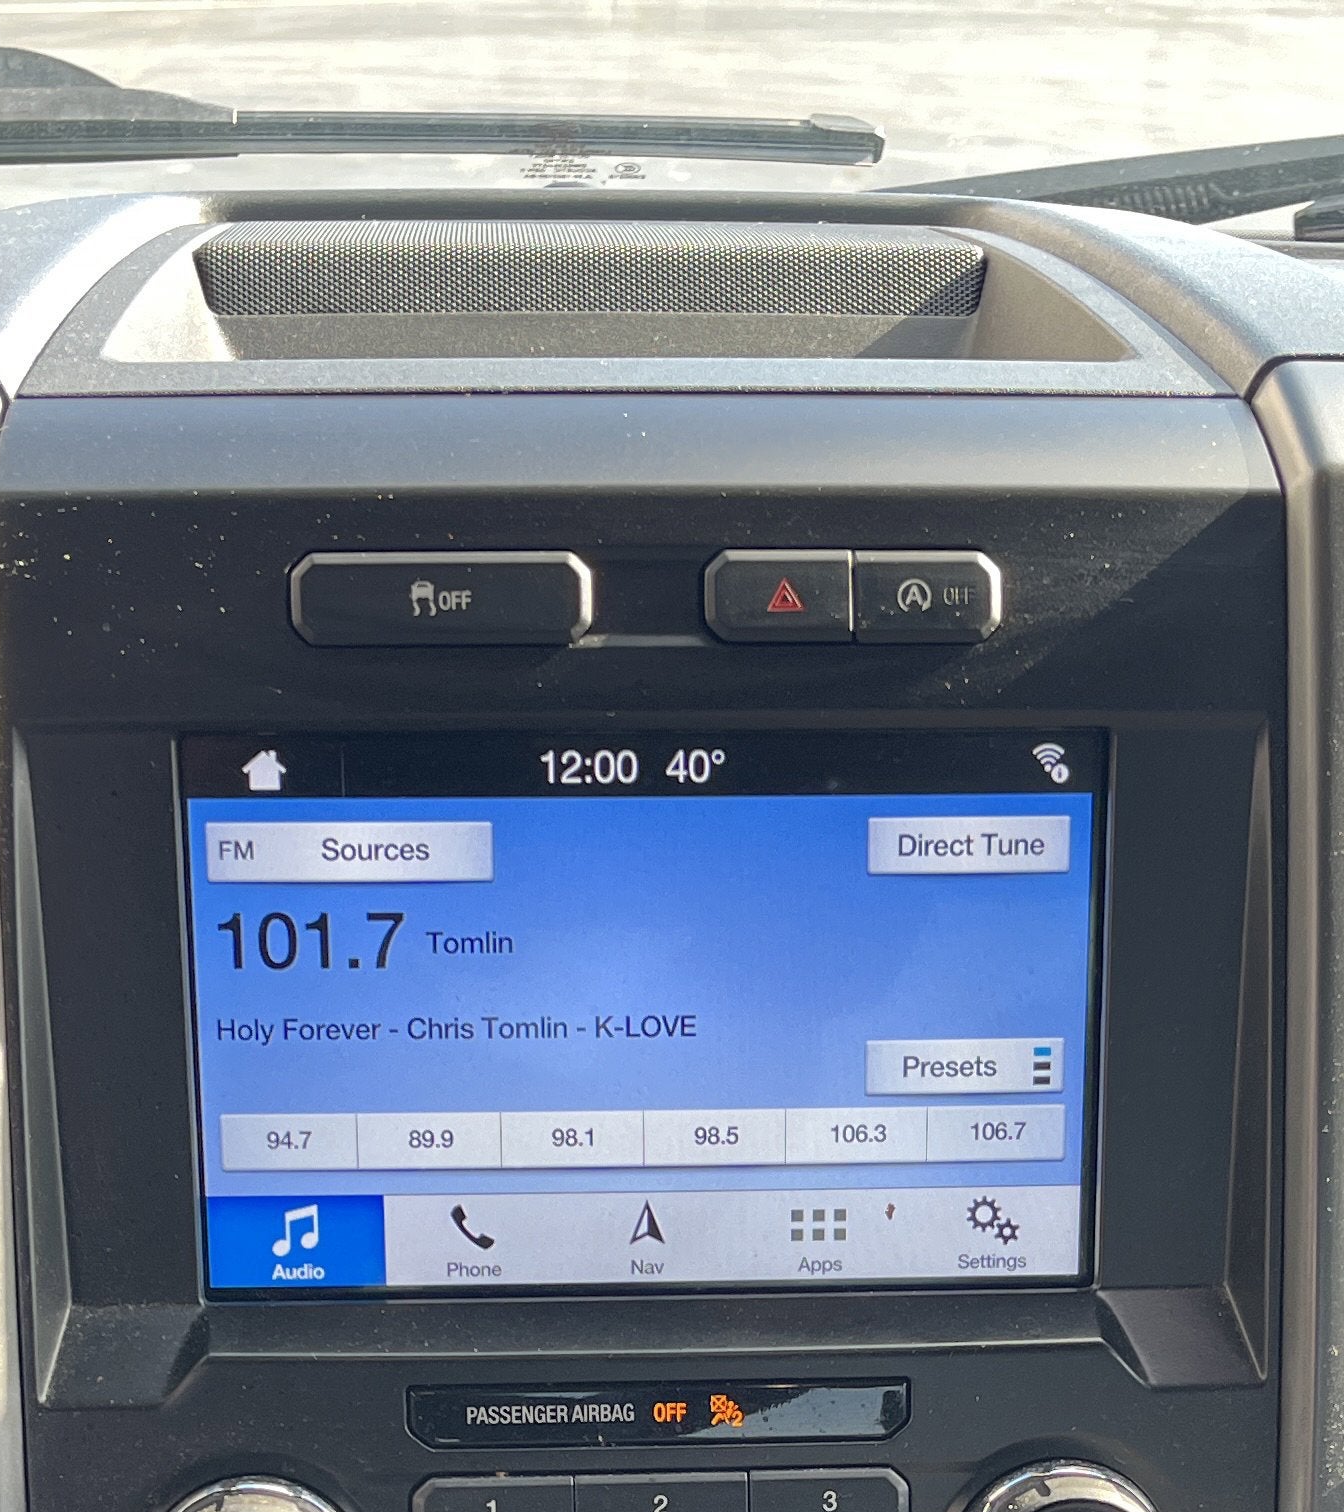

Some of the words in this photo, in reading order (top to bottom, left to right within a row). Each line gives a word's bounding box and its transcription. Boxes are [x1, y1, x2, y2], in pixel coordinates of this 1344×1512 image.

[438, 589, 473, 611] OFF
[541, 750, 638, 784] 12:00
[665, 749, 727, 784] 40°
[218, 841, 254, 860] FM
[321, 837, 430, 862] Sources
[898, 834, 973, 857] Direct
[979, 833, 1046, 857] Tune
[217, 911, 405, 970] 101.7
[426, 931, 514, 954] Tomlin
[217, 1018, 275, 1047] Holy
[283, 1018, 382, 1041] Forever
[407, 1016, 475, 1040] Chris
[482, 1016, 568, 1040] Tomlin
[595, 1014, 697, 1039] K-LOVE
[902, 1055, 998, 1078] Presets
[266, 1130, 313, 1150] 94.7
[408, 1129, 454, 1149] 89.9
[551, 1127, 595, 1148] 98.1
[694, 1126, 740, 1146] 98.5
[830, 1124, 887, 1144] 106.3
[970, 1121, 1027, 1141] 106.7
[272, 1263, 325, 1280] Audio
[446, 1261, 502, 1278] Phone
[630, 1259, 665, 1275] Nav
[798, 1257, 843, 1277] Apps
[957, 1253, 1027, 1273] Settings
[466, 1404, 568, 1425] PASSENGER
[571, 1403, 635, 1424] AIRBAG
[653, 1402, 687, 1423] OFF
[821, 1490, 838, 1512] 3
